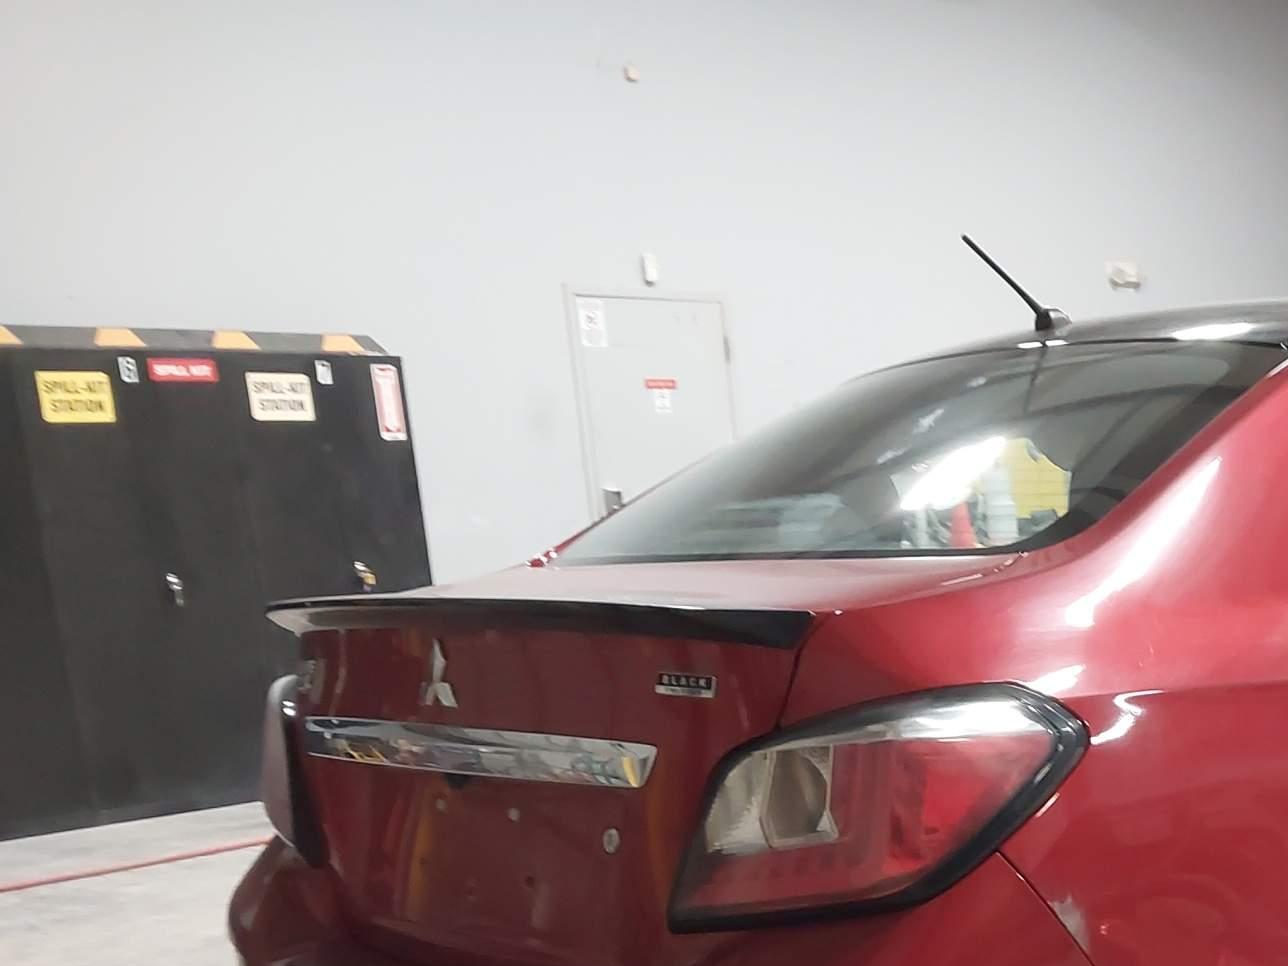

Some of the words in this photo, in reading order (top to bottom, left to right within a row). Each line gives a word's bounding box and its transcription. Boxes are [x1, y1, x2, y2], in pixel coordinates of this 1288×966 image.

[49, 399, 106, 413] STATION
[258, 399, 307, 412] STATION
[661, 674, 711, 689] BLACK
